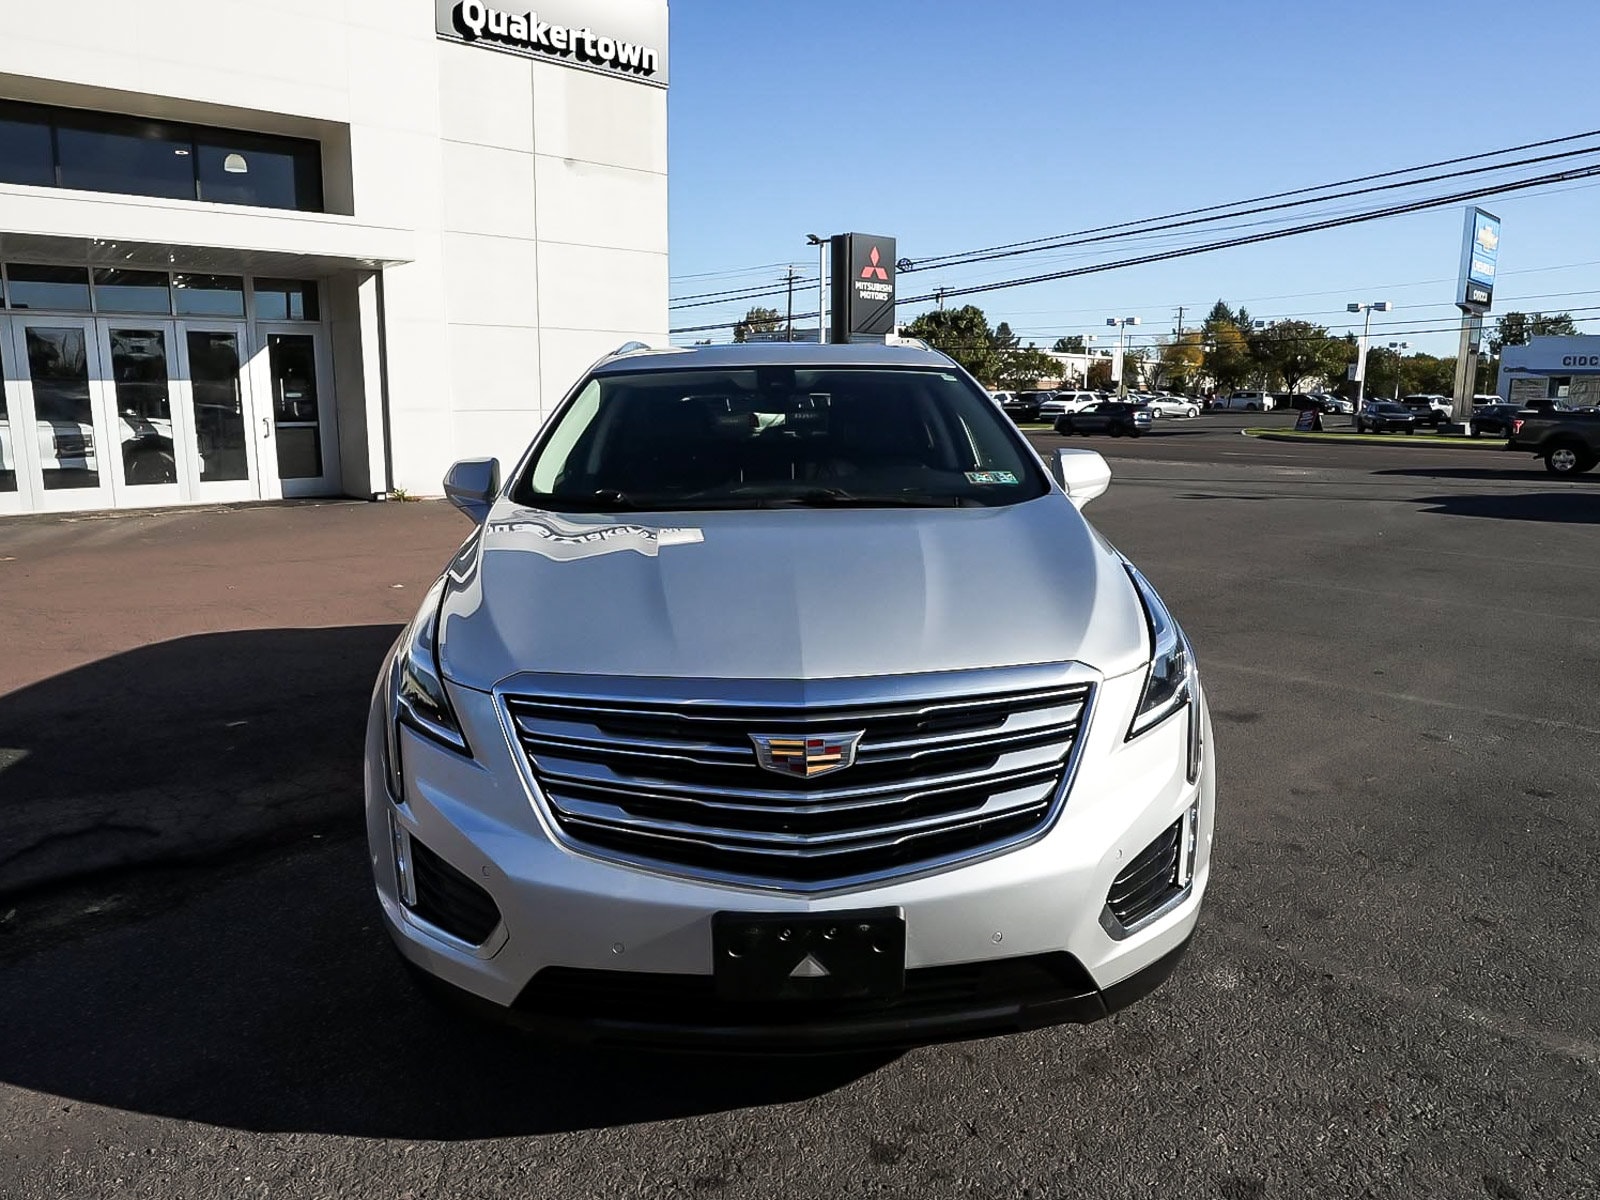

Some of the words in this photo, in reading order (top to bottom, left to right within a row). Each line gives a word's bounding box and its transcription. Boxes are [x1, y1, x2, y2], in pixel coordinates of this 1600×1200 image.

[455, 0, 659, 74] Quakertown
[855, 280, 893, 293] MITSUBISHI
[860, 290, 889, 301] MOTORS
